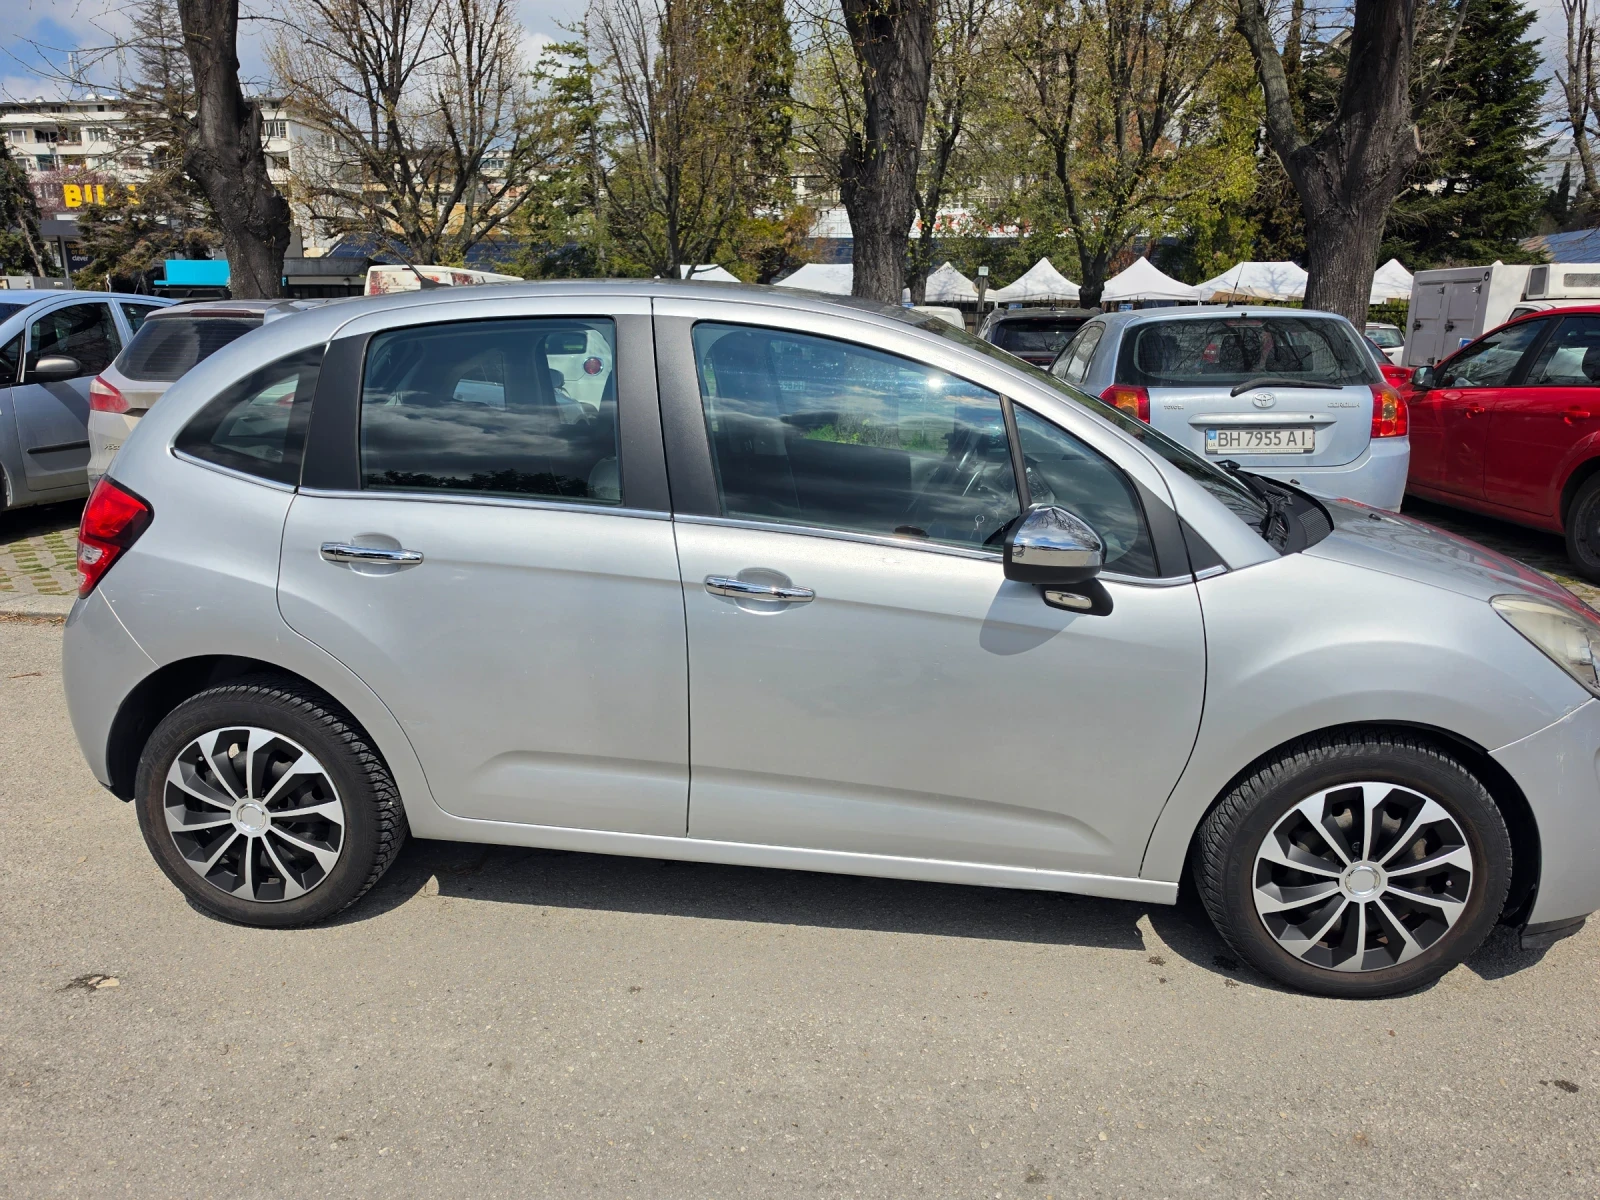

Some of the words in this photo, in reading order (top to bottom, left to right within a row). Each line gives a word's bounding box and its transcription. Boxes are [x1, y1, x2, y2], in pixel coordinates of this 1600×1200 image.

[63, 184, 140, 208] BIL
[71, 254, 89, 262] clever
[1217, 431, 1241, 448] BH
[1245, 430, 1282, 447] 7955
